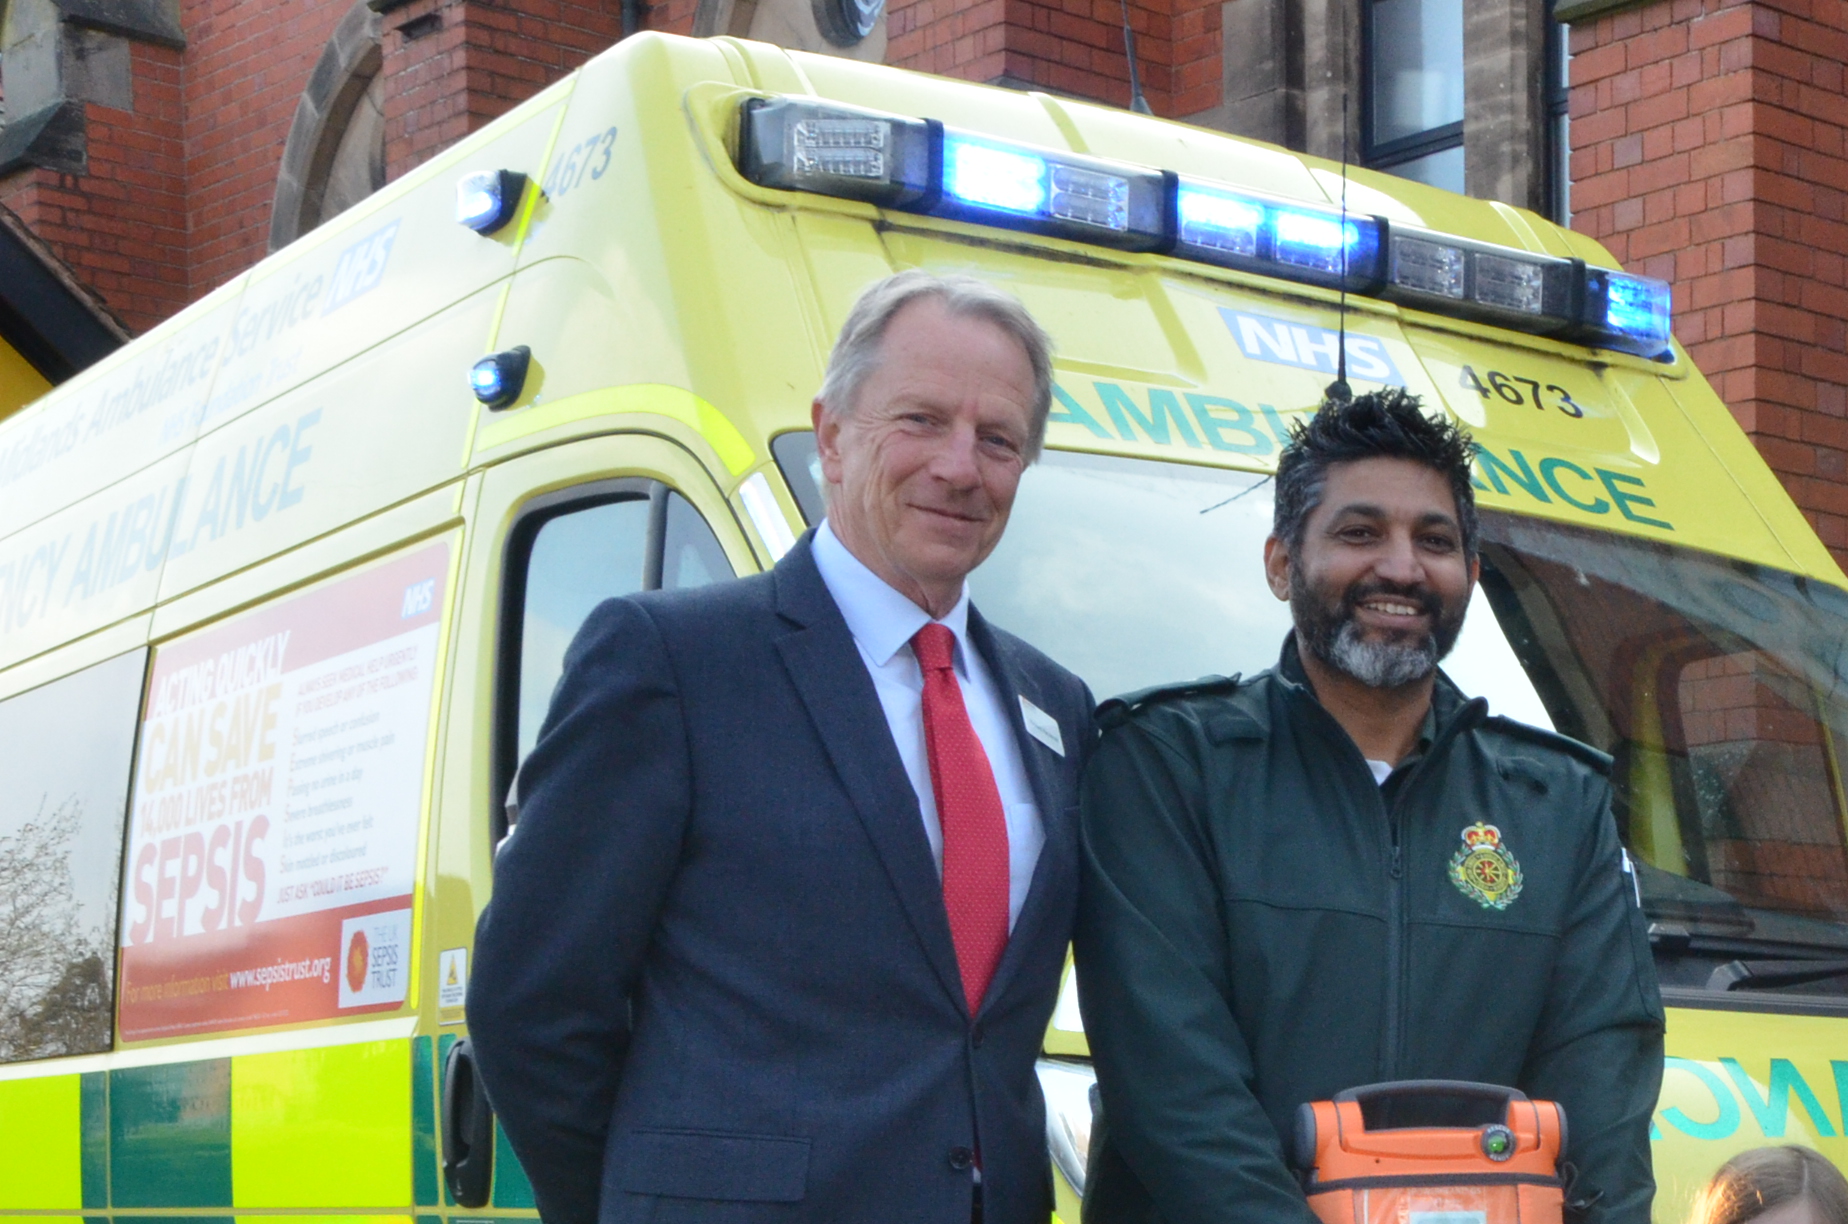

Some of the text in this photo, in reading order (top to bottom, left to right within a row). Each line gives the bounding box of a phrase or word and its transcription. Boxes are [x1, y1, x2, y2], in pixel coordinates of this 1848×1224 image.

[543, 126, 618, 196] 4673
[82, 336, 219, 444] Ambulance
[222, 271, 323, 367] Service
[325, 223, 397, 313] NHS
[1236, 315, 1391, 379] NHS
[1459, 364, 1583, 419] 4673
[63, 405, 323, 609] AMBULANCE
[402, 578, 434, 619] NHS
[153, 630, 291, 718] ACTING QUICKLY
[145, 681, 283, 795] CAN SAVE
[185, 778, 227, 826] LIVES
[229, 766, 274, 815] FROM
[130, 814, 270, 946] SEPSIS
[276, 884, 294, 904] JUST
[294, 882, 308, 900] ASK
[344, 872, 355, 890] BE
[370, 943, 399, 968] SEPSIS
[372, 923, 399, 944] THE UK
[230, 956, 332, 992] www.sepsistrust.org
[369, 967, 397, 990] TRUST
